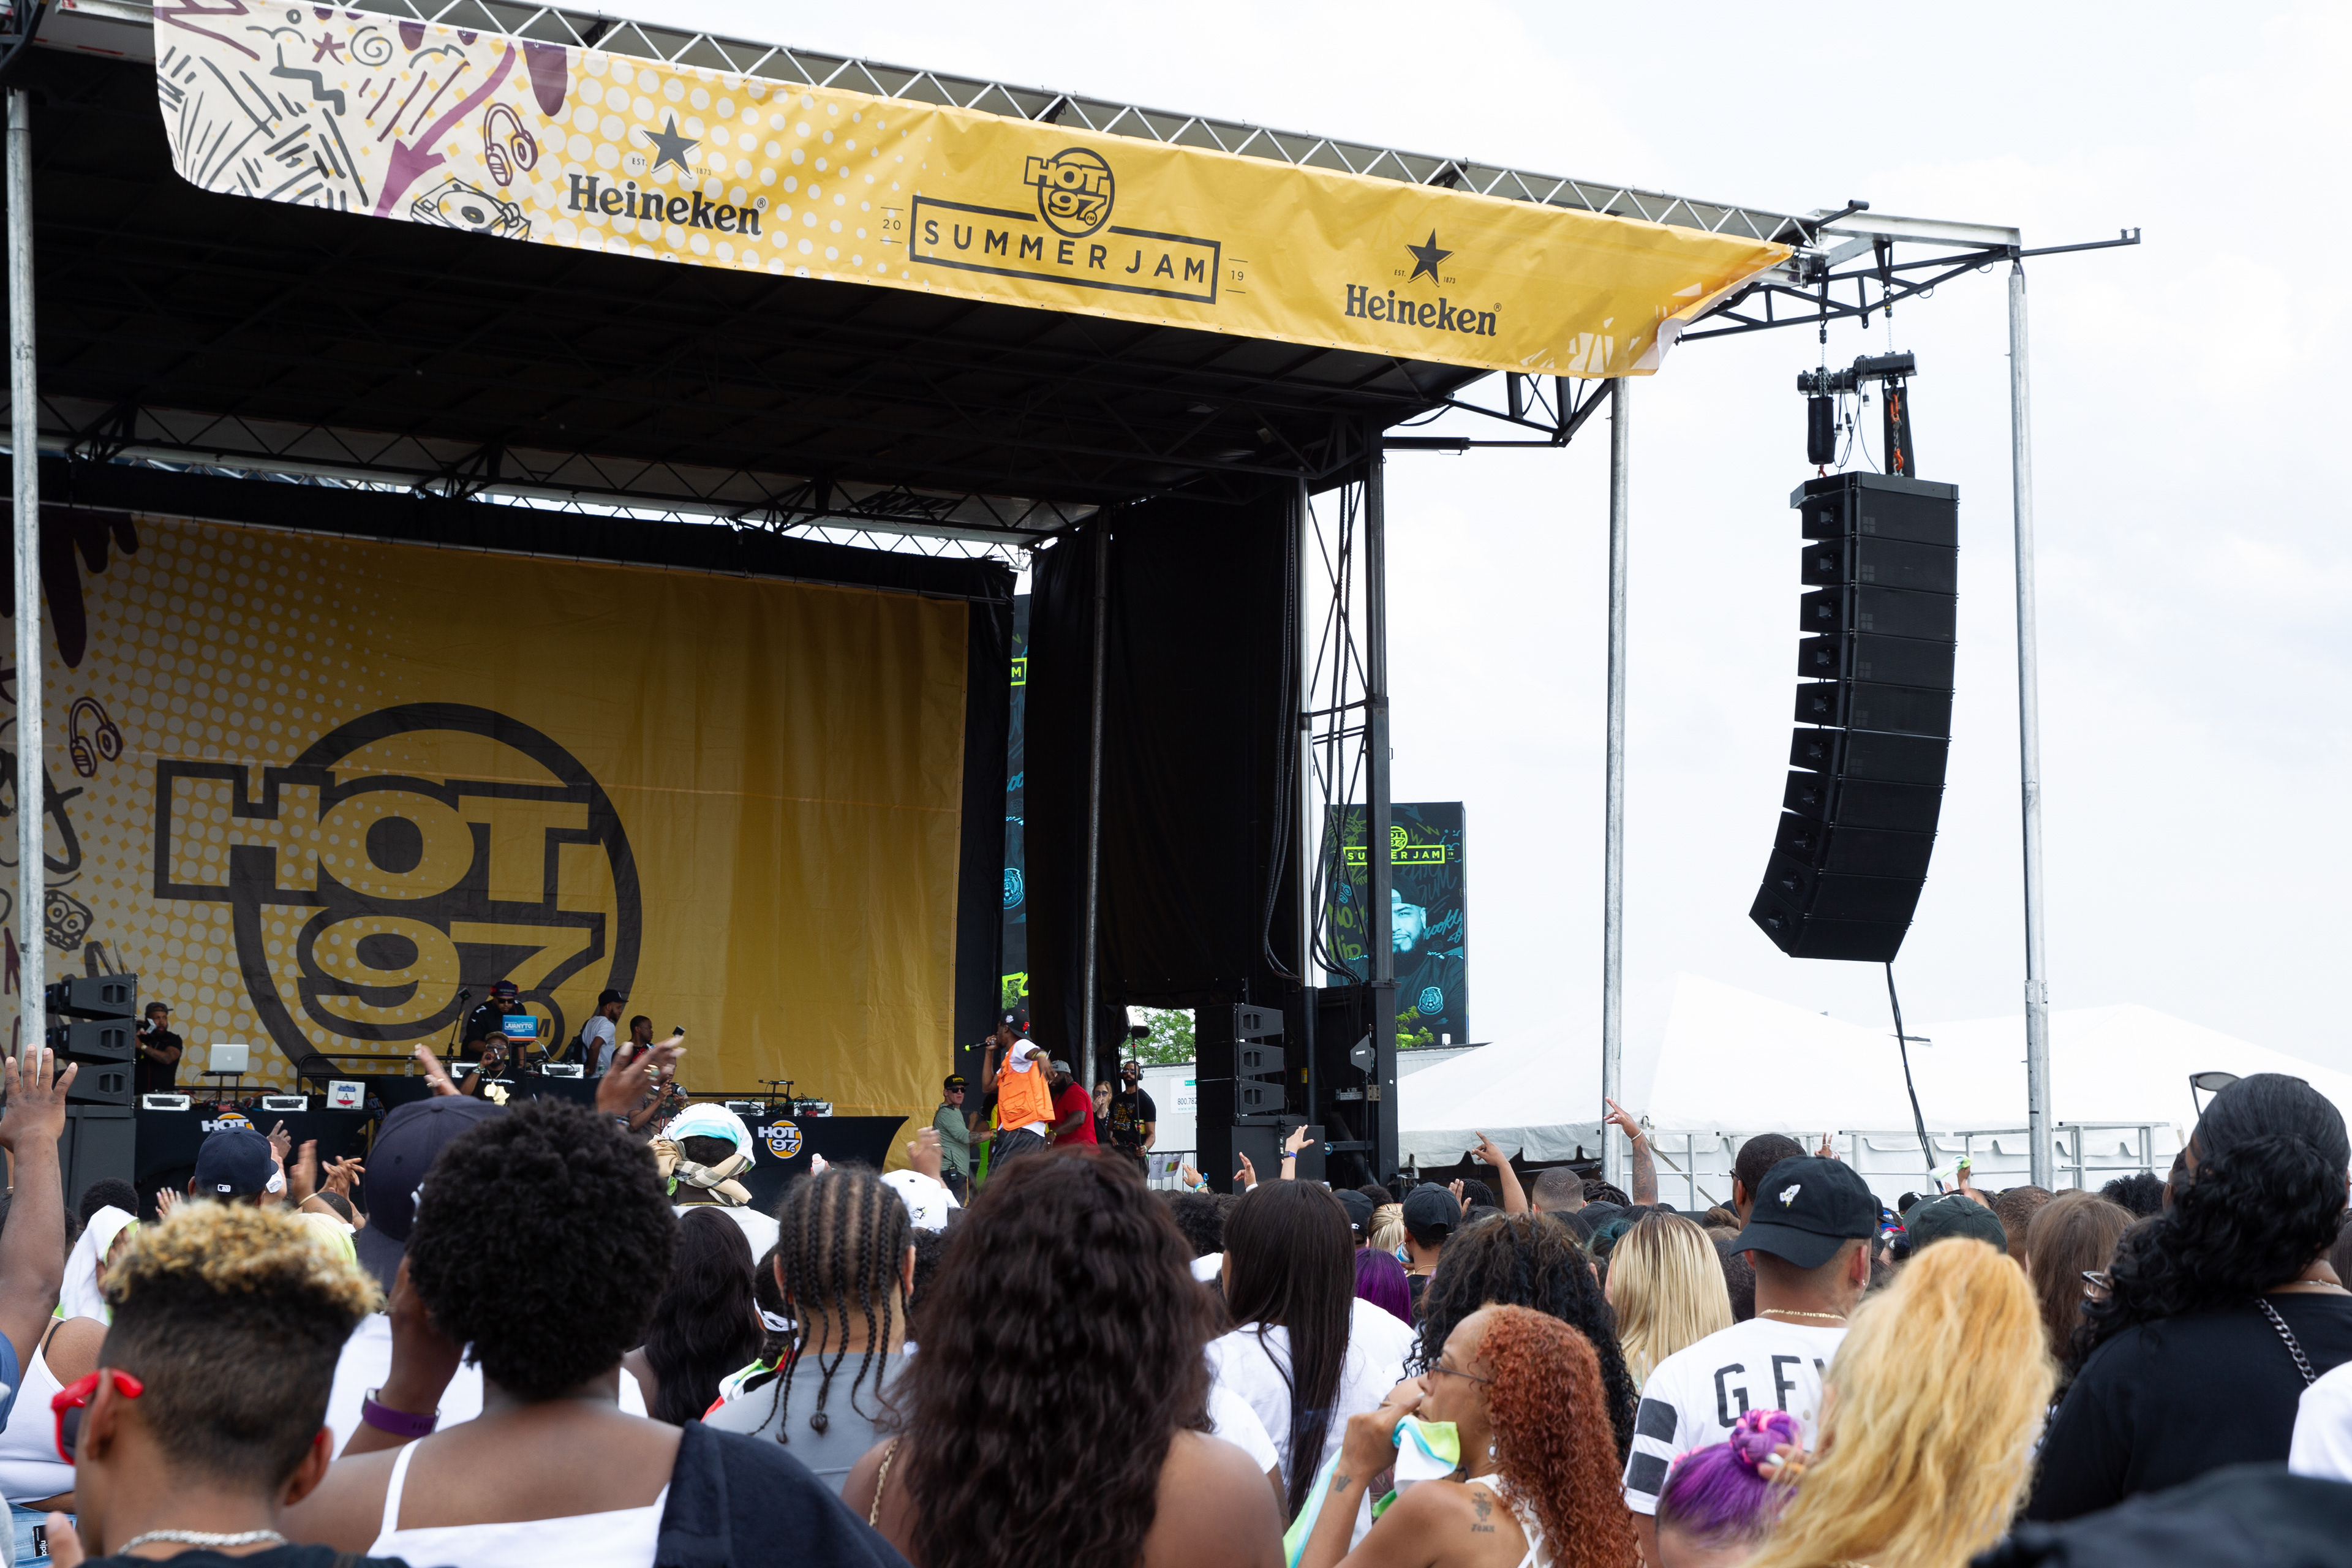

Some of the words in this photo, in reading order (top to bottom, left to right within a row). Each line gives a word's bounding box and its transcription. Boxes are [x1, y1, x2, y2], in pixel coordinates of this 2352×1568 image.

[632, 157, 648, 167] EST.
[696, 167, 712, 176] 1873
[1024, 156, 1109, 195] HOT
[1046, 185, 1107, 221] 97
[883, 219, 902, 231] 20
[924, 219, 1106, 270] SUMMER
[1125, 250, 1205, 284] JAM
[1230, 270, 1245, 282] 19
[1394, 268, 1406, 277] EST.
[1443, 276, 1456, 285] 1873
[155, 759, 603, 908] HOT
[1348, 850, 1408, 861] SUER
[1412, 850, 1441, 859] JAM
[298, 910, 606, 1040] 97
[201, 1118, 249, 1132] HOT
[758, 1126, 799, 1139] HOT
[772, 1139, 800, 1151] 97
